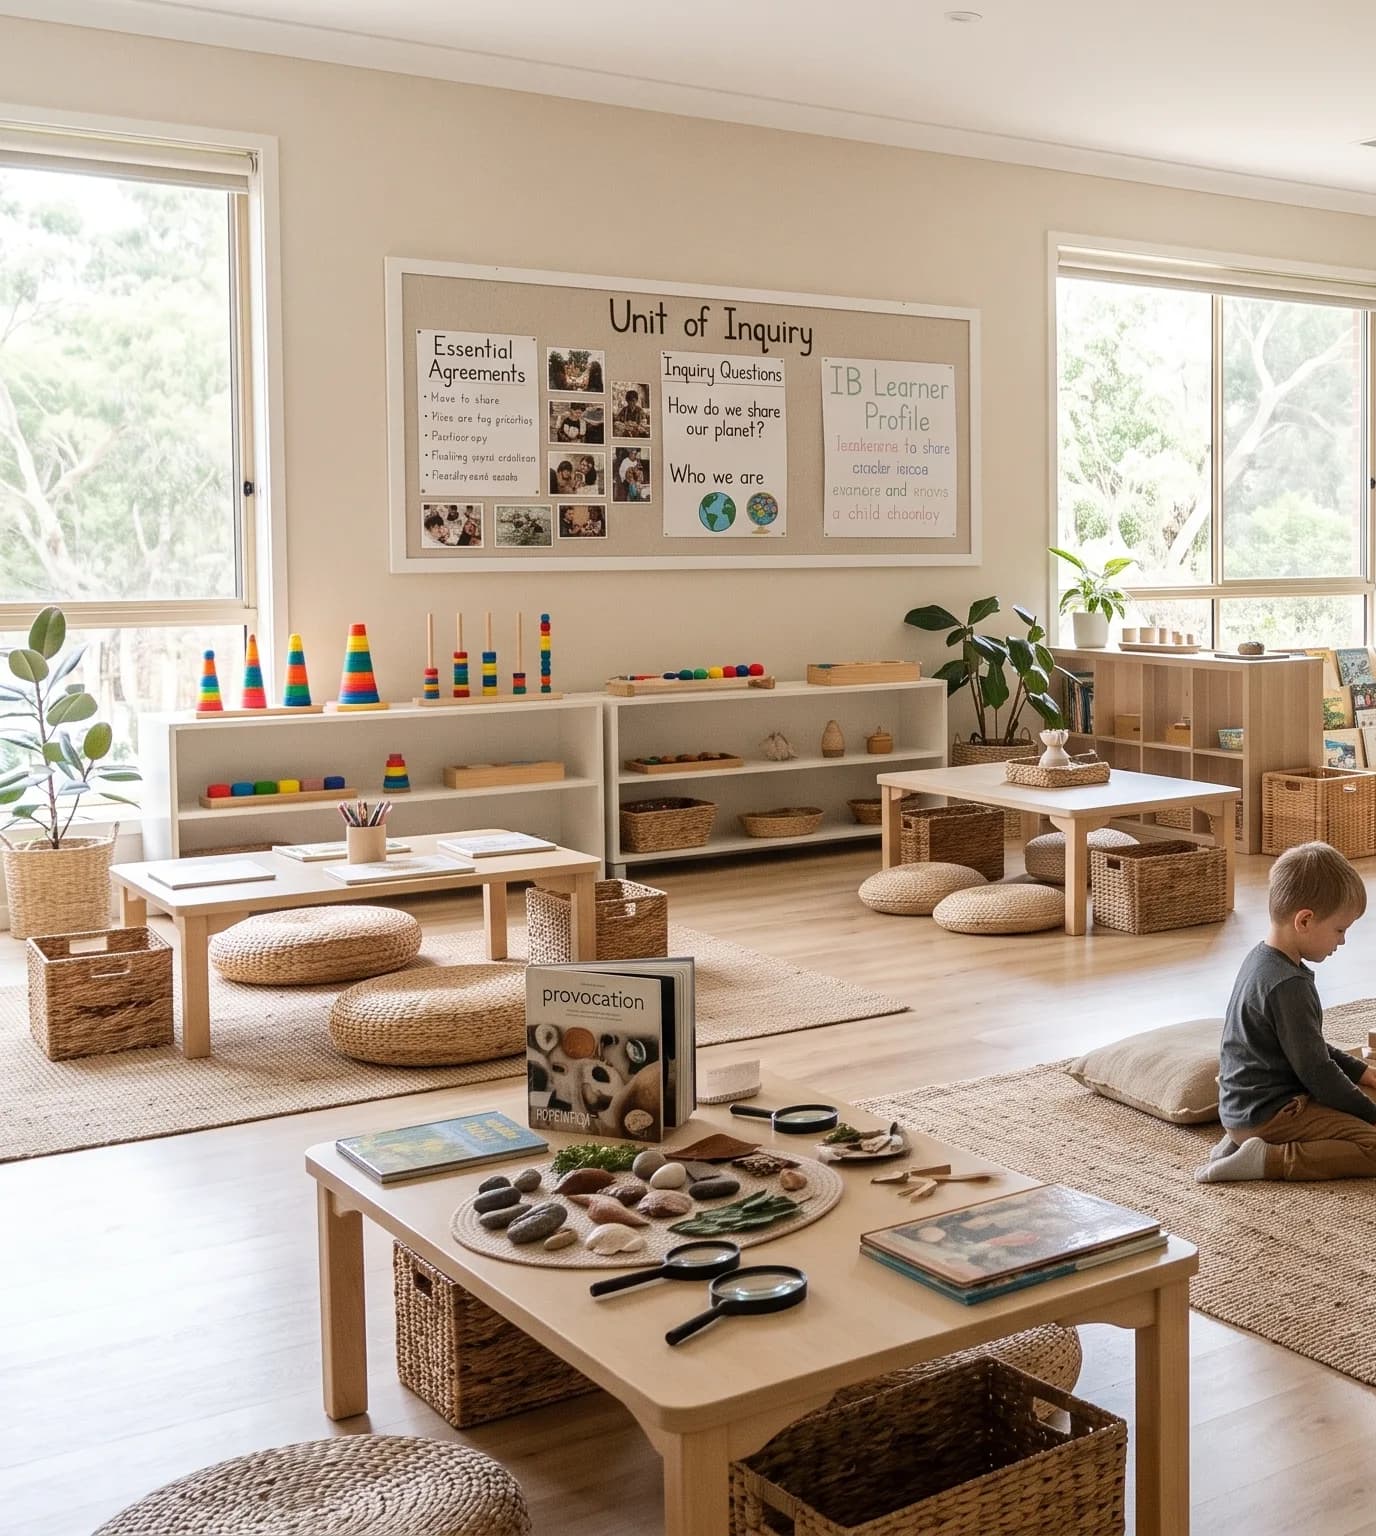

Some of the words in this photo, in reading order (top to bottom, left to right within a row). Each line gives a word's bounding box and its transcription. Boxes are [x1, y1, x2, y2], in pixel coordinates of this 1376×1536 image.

[610, 298, 668, 334] Unit
[684, 305, 710, 337] of
[724, 306, 813, 356] Inquiry
[434, 335, 512, 359] Essential
[428, 359, 526, 387] Agreements
[663, 356, 715, 386] Inquiry
[720, 360, 782, 382] Questions
[829, 365, 862, 396] IB
[874, 367, 949, 400] Learner
[475, 394, 500, 405] share
[668, 396, 698, 414] How
[703, 398, 719, 416] do
[725, 406, 742, 416] we
[747, 400, 780, 418] share
[865, 401, 930, 431] Profile
[686, 425, 709, 435] our
[714, 419, 765, 442] planet?
[923, 438, 950, 455] share
[670, 463, 706, 484] Who
[713, 472, 734, 484] we
[740, 473, 764, 485] are
[885, 481, 907, 497] and
[832, 510, 840, 520] a
[848, 504, 880, 520] child
[543, 988, 644, 1011] provocation
